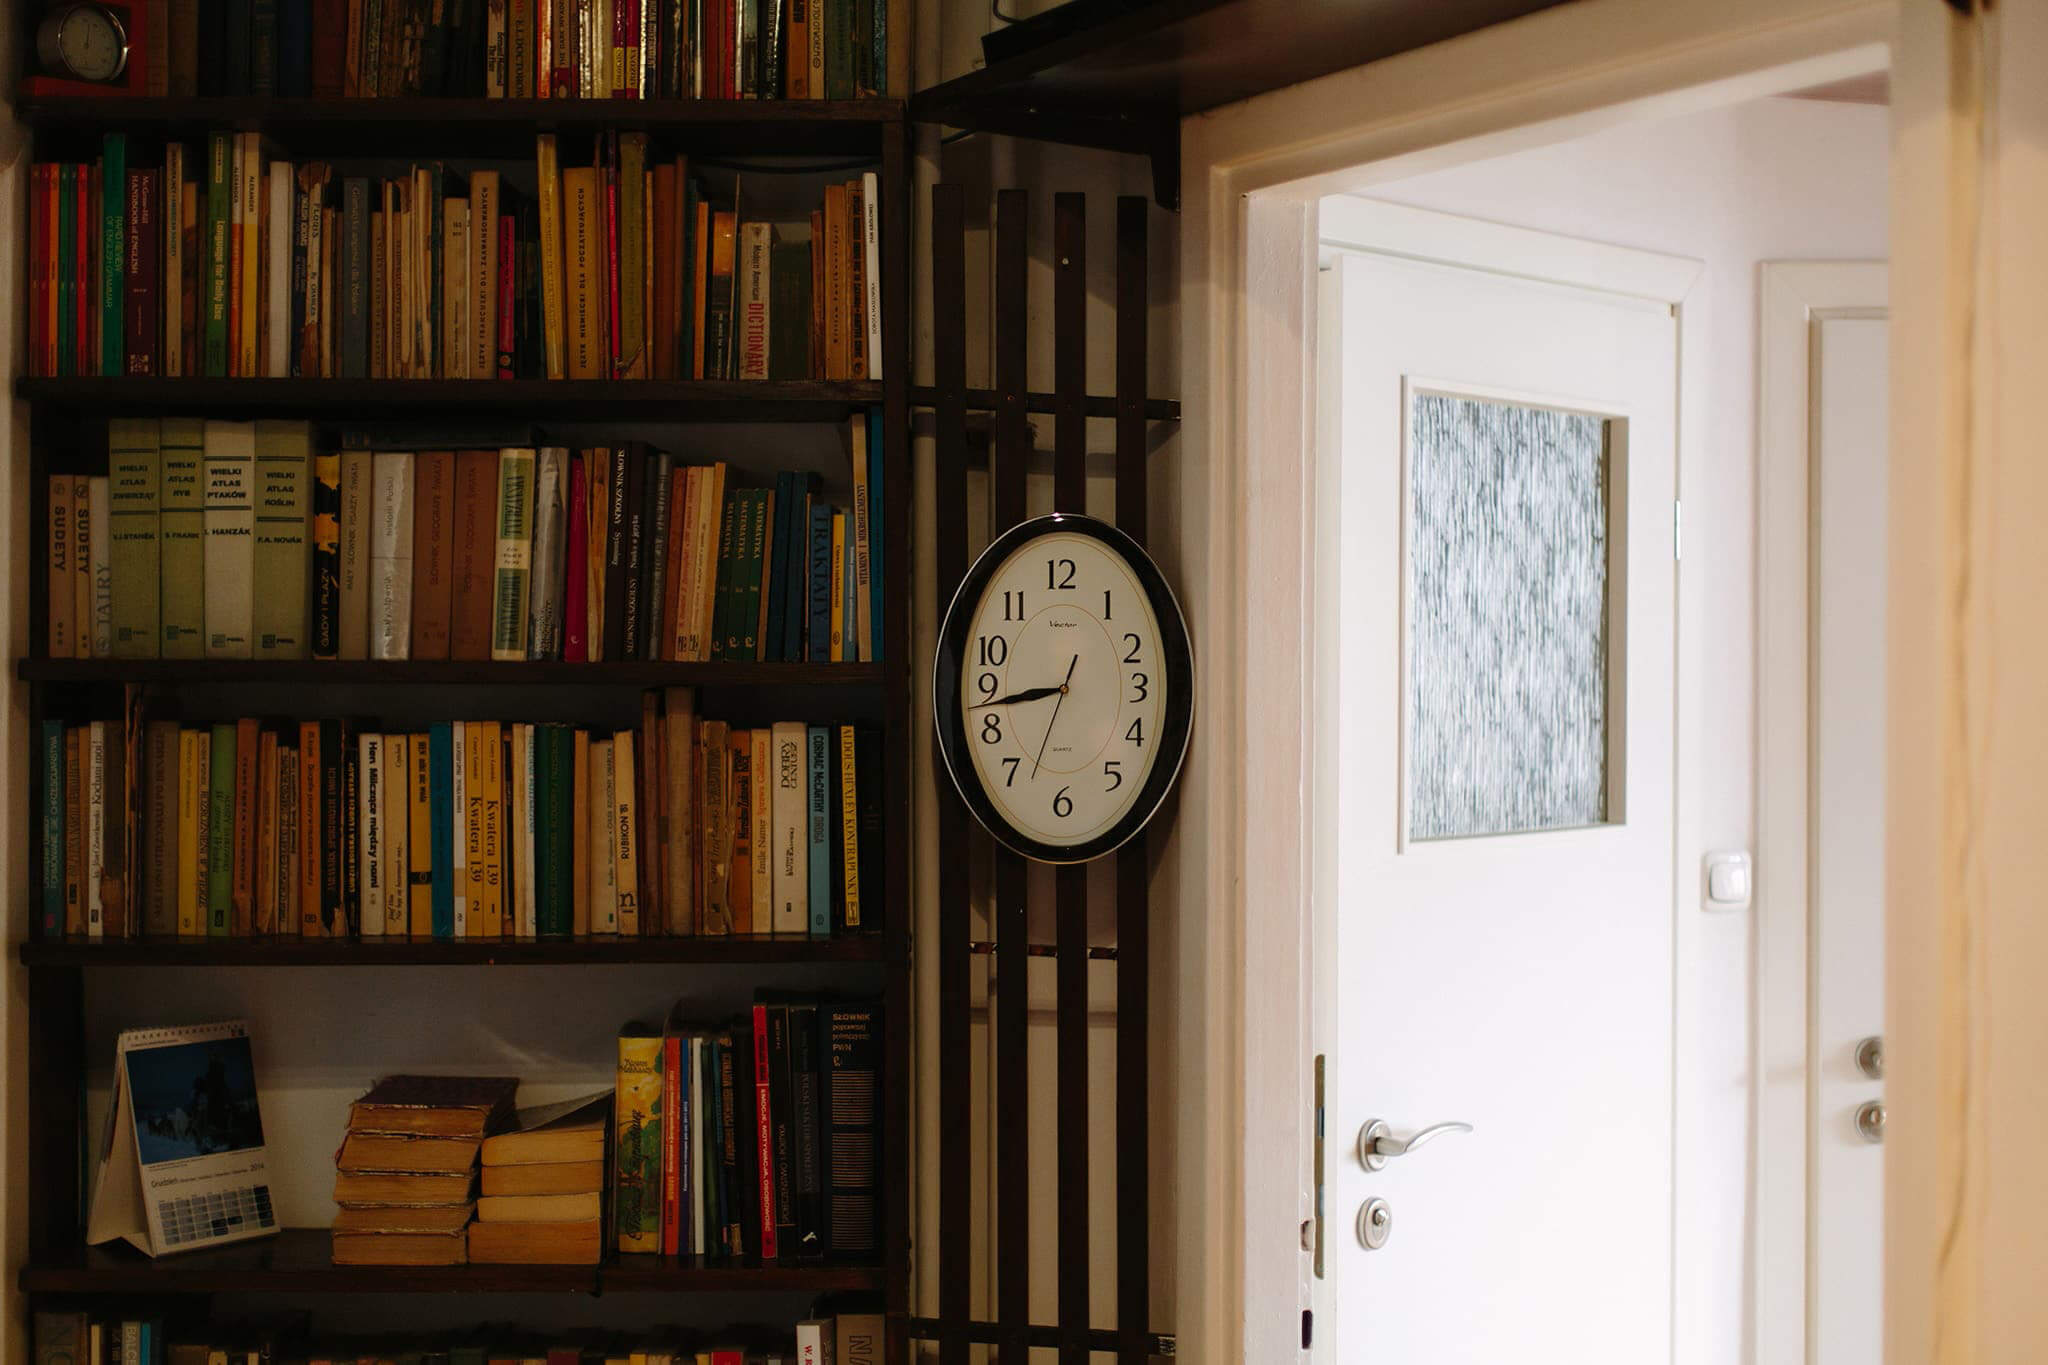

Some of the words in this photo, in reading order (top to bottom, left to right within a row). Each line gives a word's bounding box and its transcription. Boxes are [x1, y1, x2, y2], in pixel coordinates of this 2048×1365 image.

[131, 175, 139, 223] HANDBOOK
[141, 175, 150, 224] McGraw-Hill
[131, 233, 139, 274] ENGLISH
[213, 219, 225, 262] Language
[752, 244, 762, 269] Modern
[214, 264, 225, 276] for
[480, 270, 488, 287] DLA
[578, 272, 586, 289] DLA
[752, 271, 763, 300] American
[213, 279, 225, 302] Daily
[214, 304, 225, 320] Use
[747, 302, 764, 375] DICTIONARY
[210, 468, 241, 476] WIELKI
[266, 471, 295, 479] WIELKI
[616, 448, 625, 486] SŁOWNIK
[208, 490, 246, 499] PTAKÓW
[264, 498, 295, 507] ROŚLIN
[54, 506, 66, 571] SUDETY
[77, 508, 90, 574] SUDETY
[212, 527, 251, 536] HANZÁK
[274, 536, 303, 544] NOVÁK
[736, 500, 749, 560] MATEMATYKA
[751, 501, 765, 559] MATEMATYKA
[813, 514, 829, 619] TRAKTATY
[858, 552, 868, 586] WITAMINY
[1046, 559, 1078, 590] 12
[1003, 590, 1026, 622] 11
[1103, 590, 1113, 621] 1
[978, 634, 1008, 666] 10
[1122, 633, 1142, 664] 2
[977, 672, 999, 705] 9
[1128, 672, 1149, 703] 3
[980, 713, 1002, 745] 8
[1124, 717, 1145, 748] 4
[813, 735, 825, 769] CORMAC
[842, 727, 854, 769] ALDOUS
[347, 761, 355, 797] ESTRADY
[781, 740, 791, 790] DOBRY
[1001, 757, 1022, 788] 7
[1103, 761, 1122, 793] 5
[91, 765, 102, 805] Kochani
[367, 767, 379, 814] Milczące
[813, 771, 825, 813] McCARTHY
[843, 772, 855, 815] HUXLEY
[347, 799, 355, 827] LUDZIE
[1052, 785, 1074, 818] 6
[365, 816, 379, 858] między
[470, 796, 482, 853] Kwatera
[487, 799, 498, 856] Kwatera
[619, 815, 631, 860] RUBIKON
[758, 820, 766, 848] Namer
[813, 815, 825, 844] DROGA
[470, 860, 482, 882] 139
[756, 852, 767, 875] Émile
[844, 818, 857, 897] KONTRAPUNKT
[347, 864, 355, 892] LUDZIE
[369, 860, 380, 889] nami
[487, 864, 498, 885] 139
[759, 1088, 768, 1123] EMOCJE,
[760, 1124, 769, 1178] MOTYWACJA,
[762, 1179, 772, 1232] OSOBOWOŚĆ
